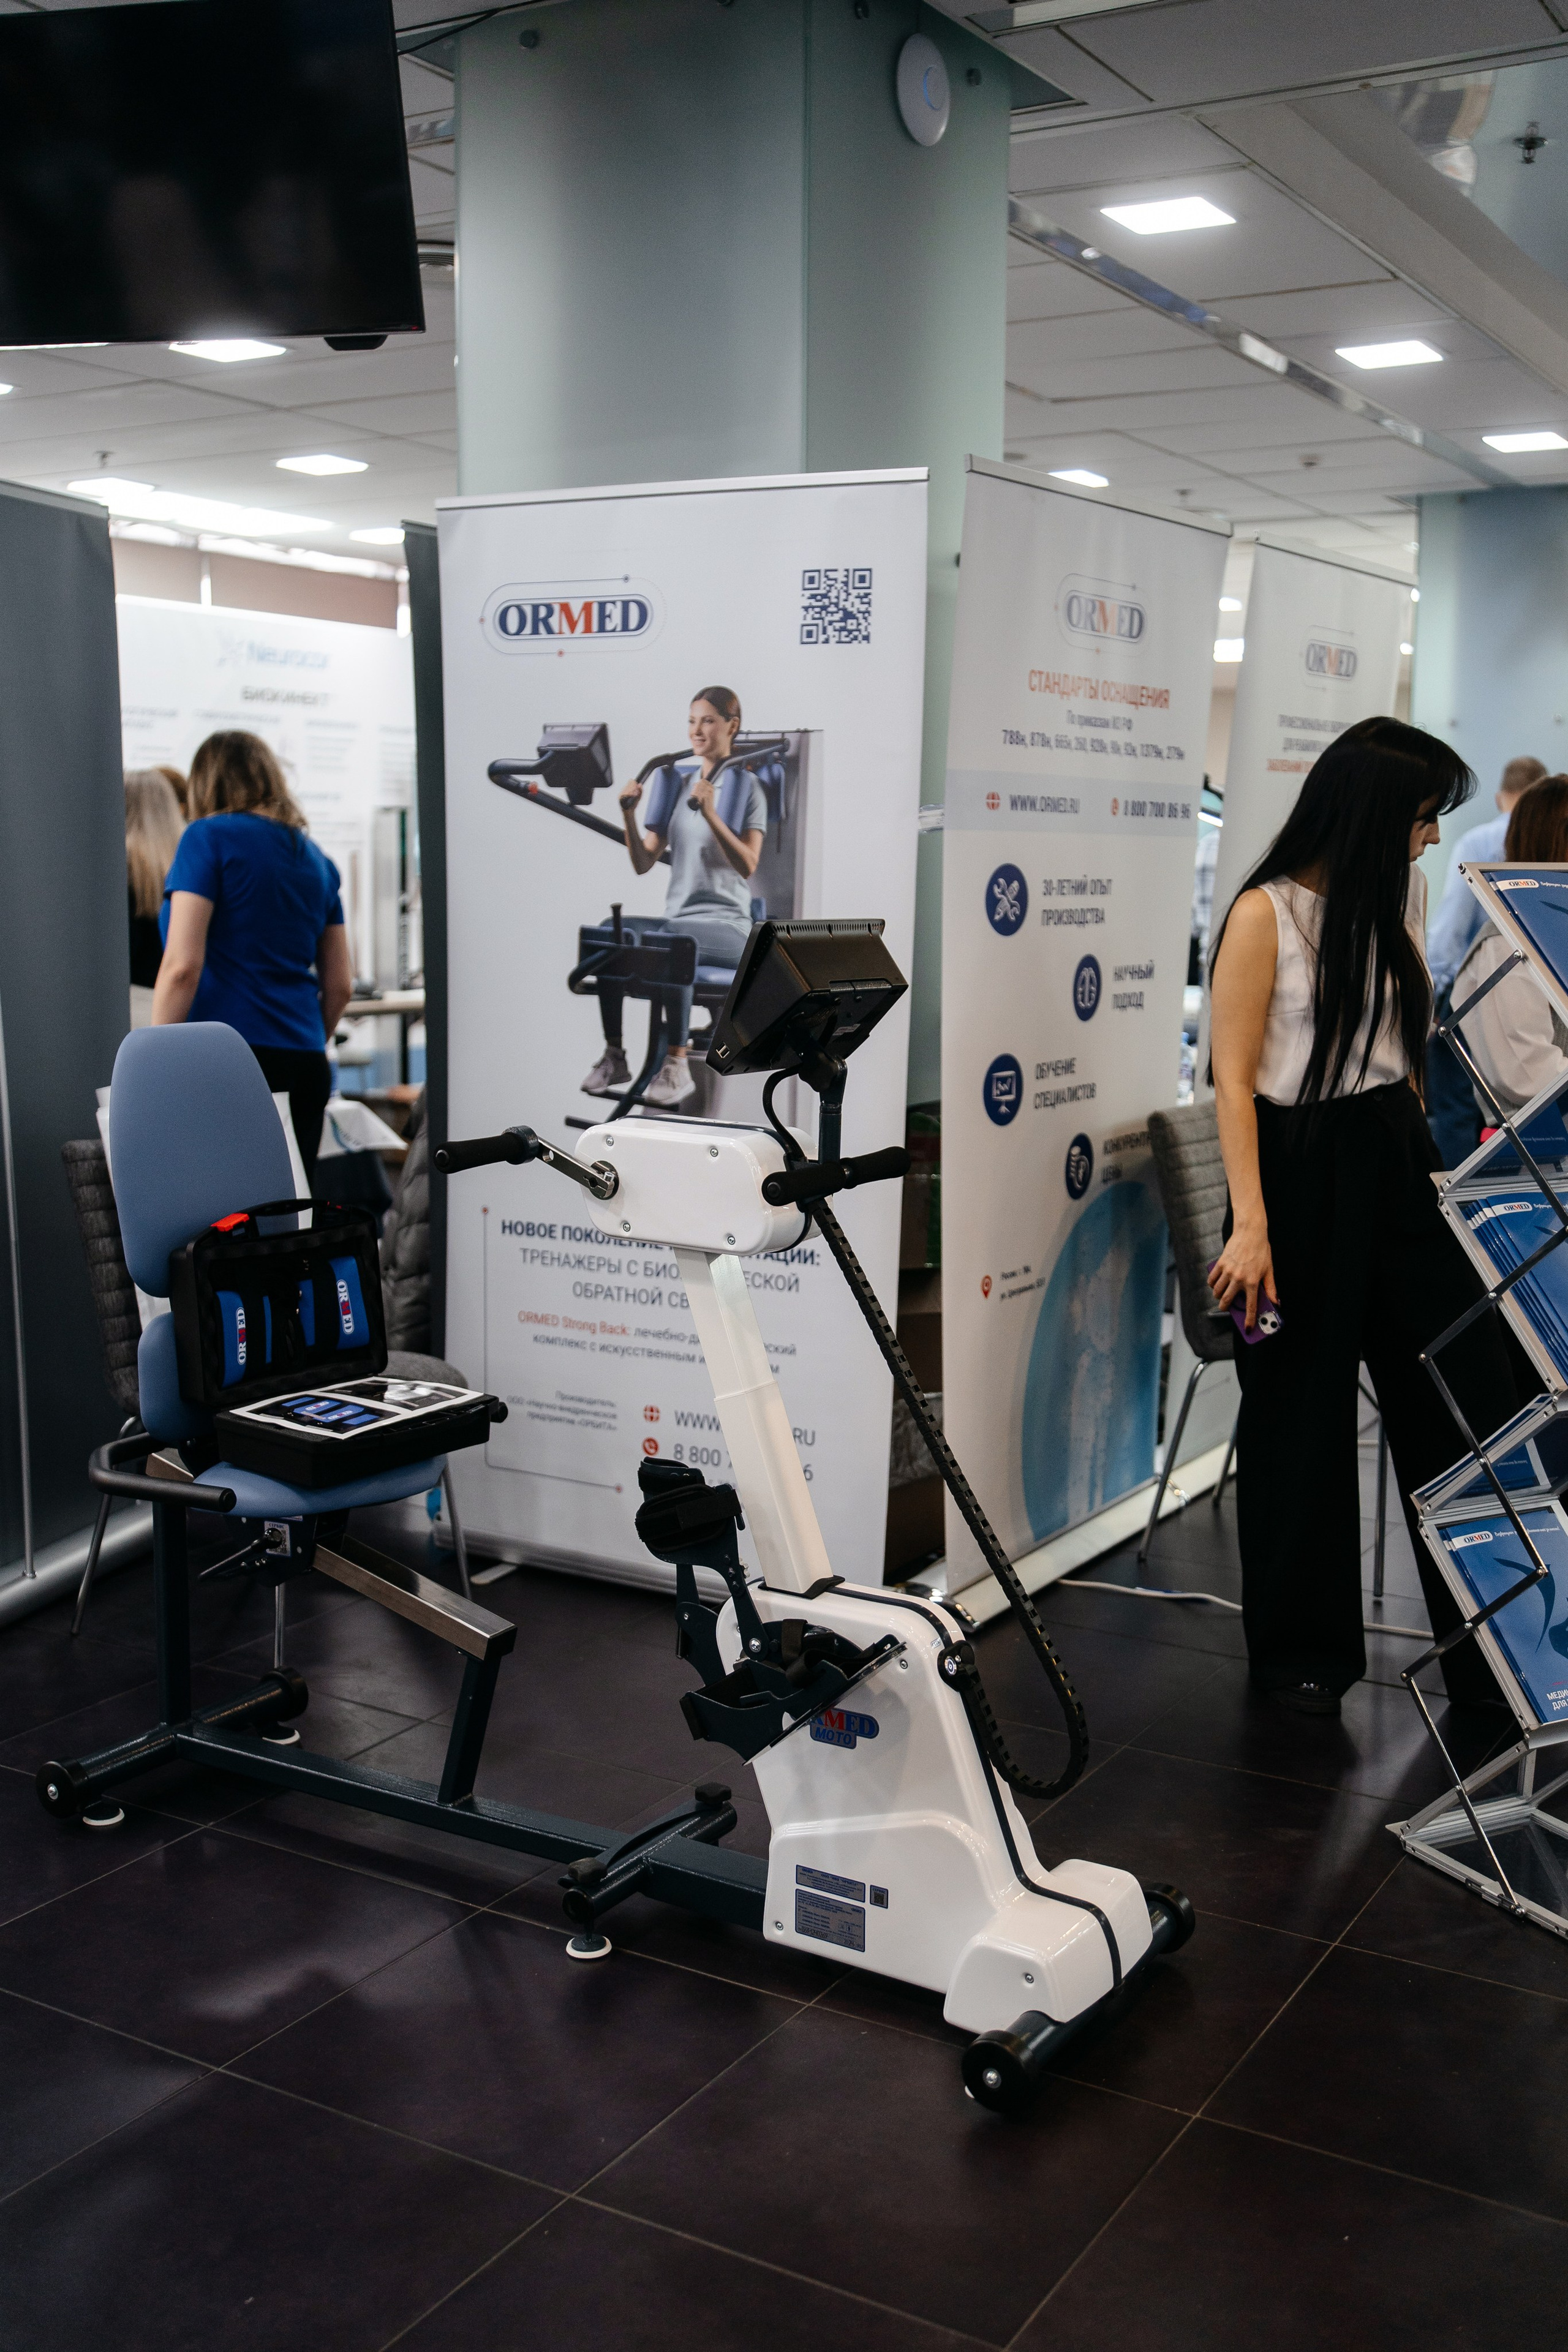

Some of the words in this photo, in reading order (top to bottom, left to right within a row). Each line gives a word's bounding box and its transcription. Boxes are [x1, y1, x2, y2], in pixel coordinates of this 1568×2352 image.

[499, 599, 647, 635] ORMED
[1067, 594, 1144, 639] ORMED
[1305, 643, 1357, 677] ORMED
[1028, 669, 1100, 700] СТАНДАРТЫ
[1102, 680, 1170, 710] ОСНАЩЕНИЯ
[1009, 795, 1080, 814] WWW.ORMED.RU
[1043, 874, 1088, 896] 30-ЛЕТНИЙ
[1090, 878, 1112, 895] ОПЫТ
[1042, 907, 1106, 927] ПРОИЗВОДСТВА
[1114, 959, 1155, 981] НАУЧНЫЙ
[1035, 1057, 1077, 1080] ОБУЧЕНИЕ
[1033, 1083, 1097, 1109] СПЕЦИАЛИСТОВ
[501, 1219, 557, 1240] НОВОЕ
[521, 1247, 622, 1274] ТРЕНАЖЕРЫ
[572, 1281, 663, 1305] ОБРАТНОЙ
[337, 1280, 353, 1333] ORMED
[518, 1310, 559, 1327] ORMED
[562, 1316, 597, 1335] Strong
[237, 1309, 246, 1364] ORMED
[533, 1333, 588, 1351] комплекс
[598, 1343, 697, 1364] искусственным
[674, 1442, 684, 1461] 8
[689, 1445, 722, 1467] 800
[1464, 1532, 1491, 1544] ORMED
[1551, 1700, 1568, 1711] ДЛЯ
